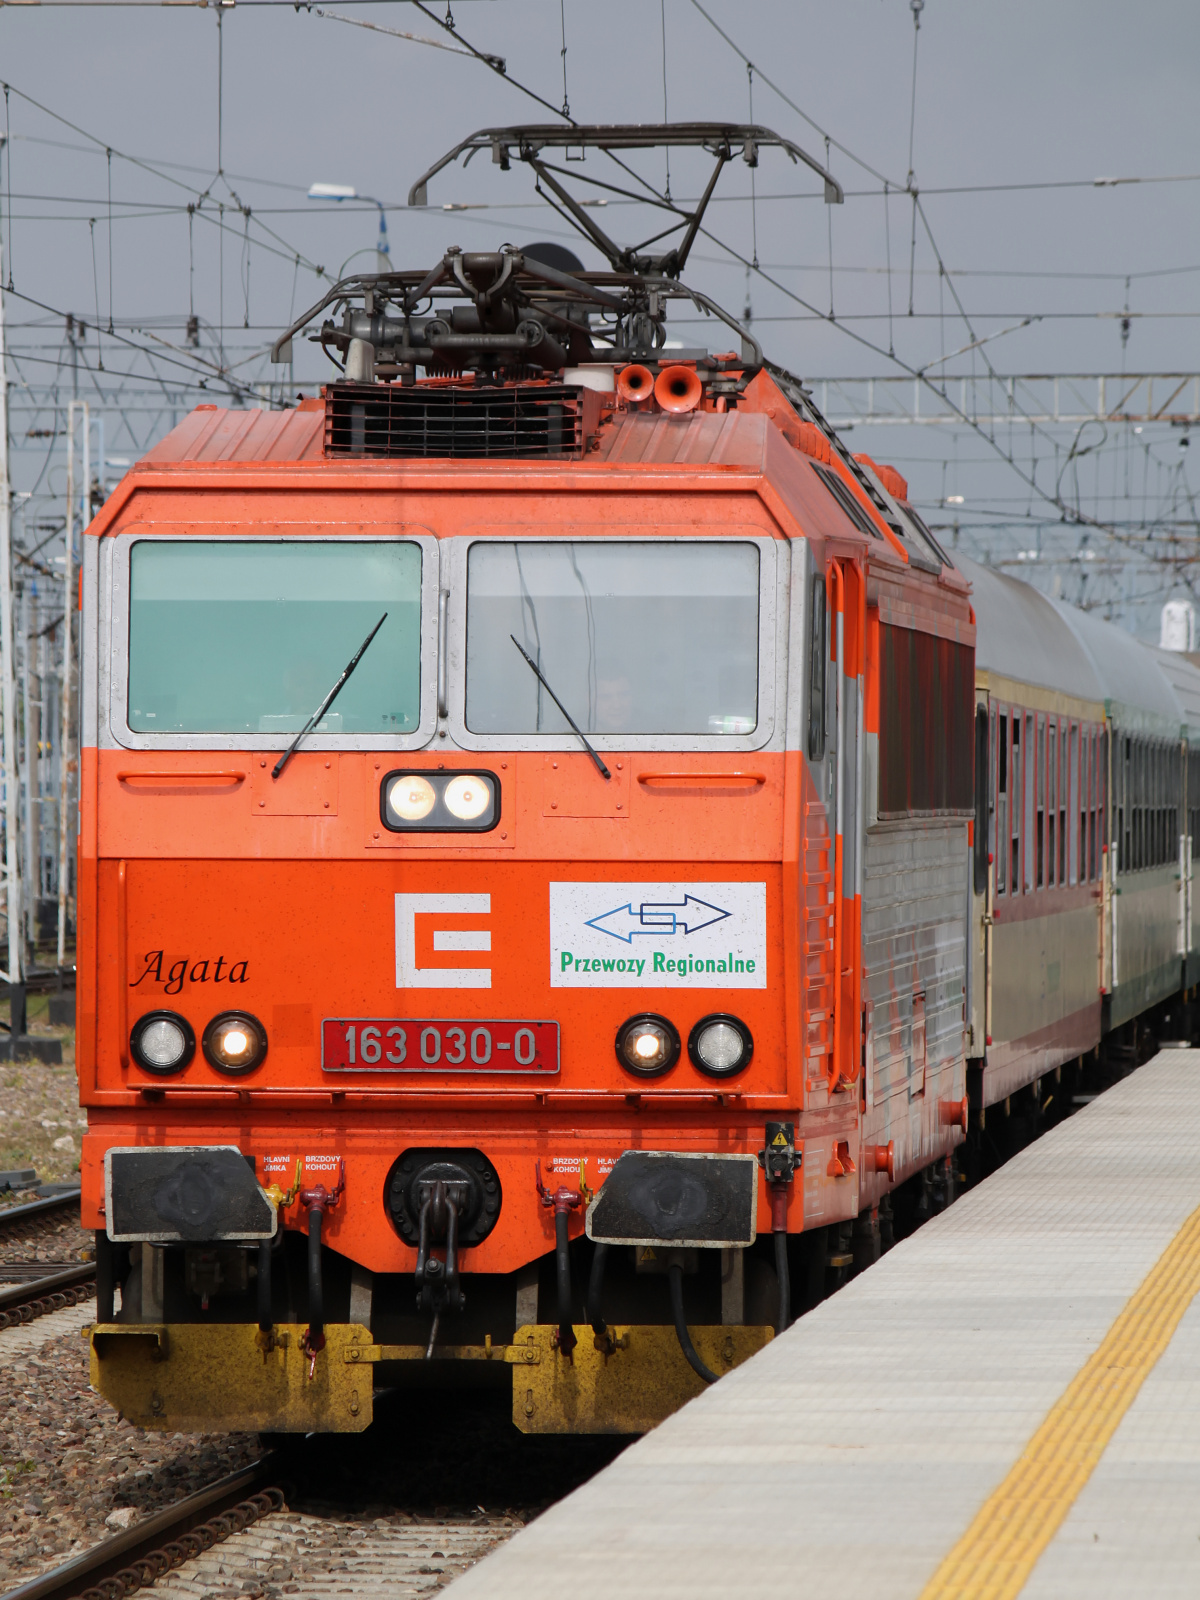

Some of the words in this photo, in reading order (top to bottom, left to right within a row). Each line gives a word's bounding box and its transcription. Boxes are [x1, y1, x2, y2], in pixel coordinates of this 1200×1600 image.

[561, 951, 646, 977] Przewozy
[653, 952, 756, 977] Regionalne
[129, 950, 249, 995] Agata
[345, 1025, 407, 1064] 163
[420, 1026, 536, 1065] 030-0
[264, 1155, 290, 1163] HLAVNÍ
[305, 1154, 341, 1162] BRZDOVÝ
[553, 1157, 588, 1165] BRZDOÝ
[264, 1163, 286, 1171] JÍMKA
